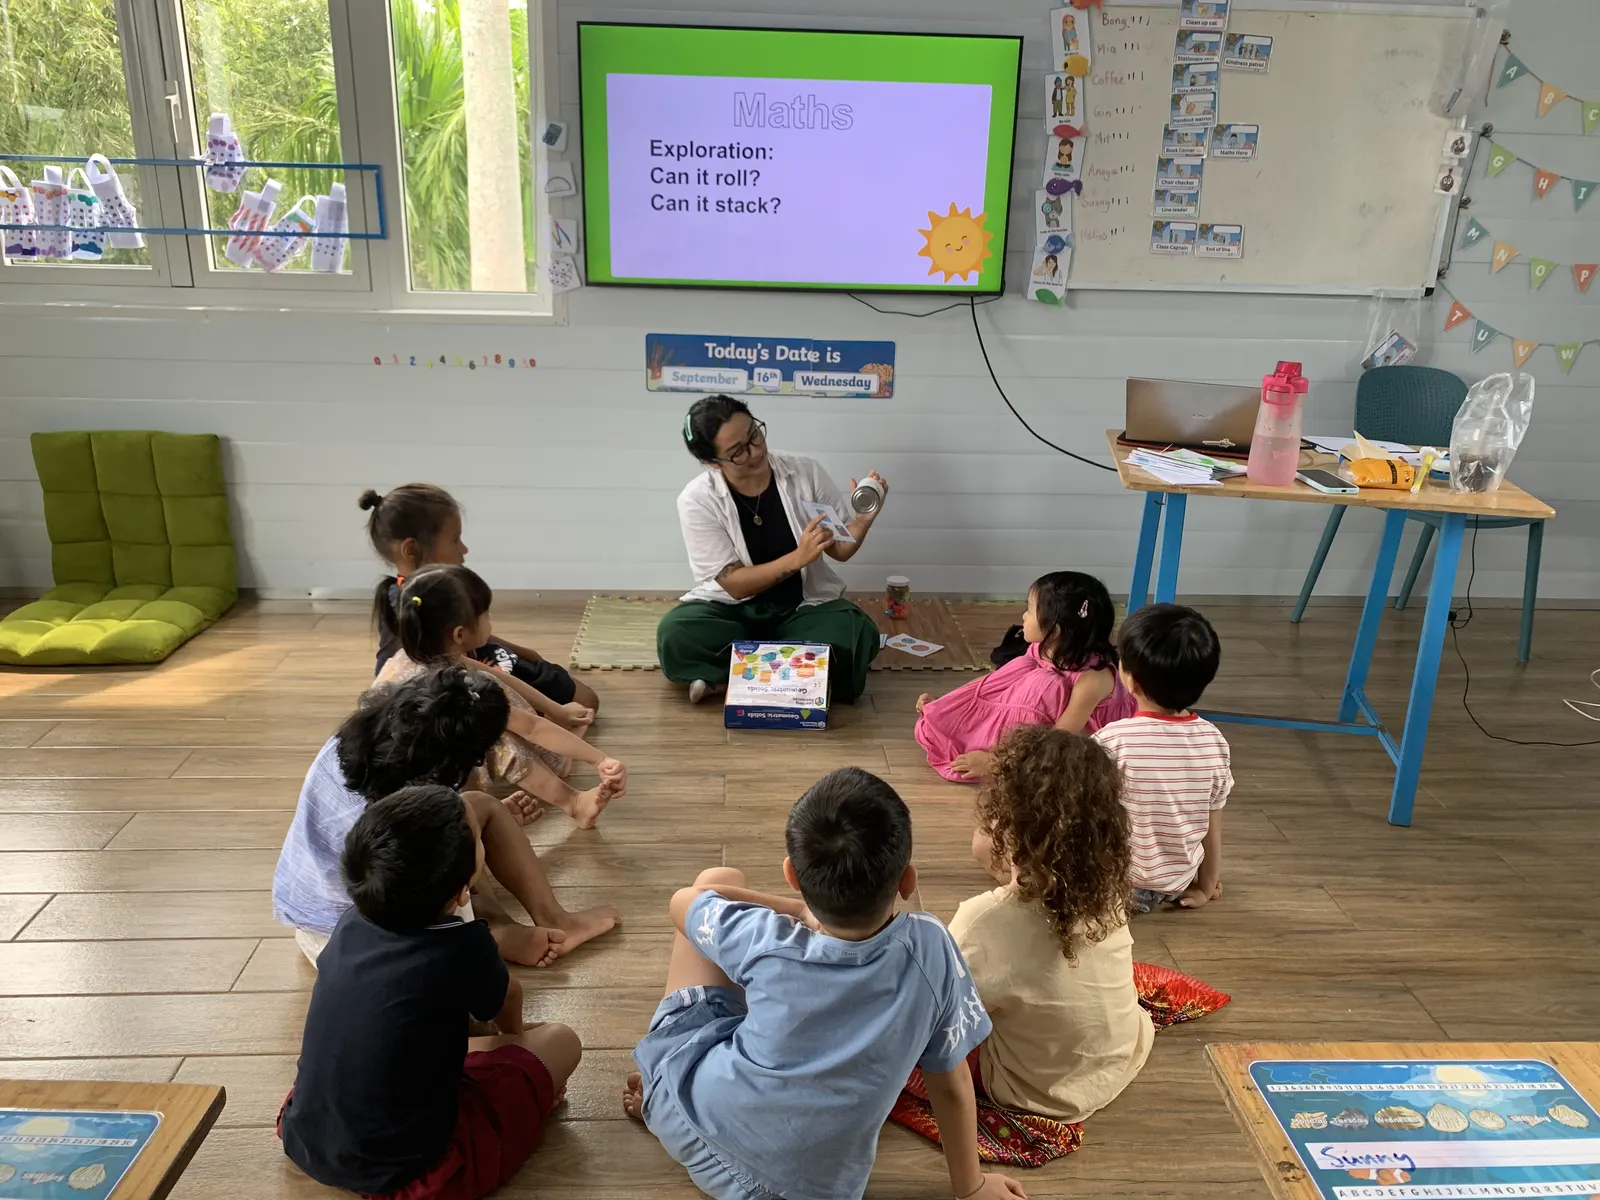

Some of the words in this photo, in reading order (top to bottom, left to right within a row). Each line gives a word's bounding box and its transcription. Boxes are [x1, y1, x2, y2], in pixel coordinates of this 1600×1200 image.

[1097, 43, 1117, 54] Mia
[1092, 71, 1126, 85] Coffee
[1506, 66, 1518, 78] A
[1544, 92, 1555, 104] B
[1589, 109, 1598, 120] C
[733, 92, 854, 130] Maths
[650, 139, 774, 161] Exploration:
[650, 167, 689, 185] Can
[697, 168, 709, 185] it
[716, 169, 760, 186] roll?
[1493, 156, 1504, 167] G
[1538, 177, 1549, 190] H
[1577, 187, 1587, 199] I
[651, 194, 689, 212] Can
[697, 195, 709, 212] it
[716, 197, 781, 214] stack?
[1467, 227, 1480, 240] M
[1496, 249, 1508, 262] N
[1535, 265, 1545, 276] O
[1580, 270, 1590, 282] P
[1451, 310, 1463, 322] T
[1477, 329, 1488, 341] U
[1519, 345, 1529, 356] V
[1561, 349, 1575, 359] W
[409, 356, 416, 366] 2
[439, 355, 446, 364] 4
[468, 360, 476, 370] 6
[494, 354, 502, 364] 8
[508, 358, 515, 368] 9
[704, 343, 770, 364] Today's
[775, 345, 821, 362] Date
[826, 346, 841, 364] is
[672, 370, 739, 387] September
[756, 371, 779, 384] 16th
[801, 375, 872, 390] Wednesday
[1333, 1117, 1369, 1126] Tuesday
[1320, 1146, 1416, 1172] Sunny
